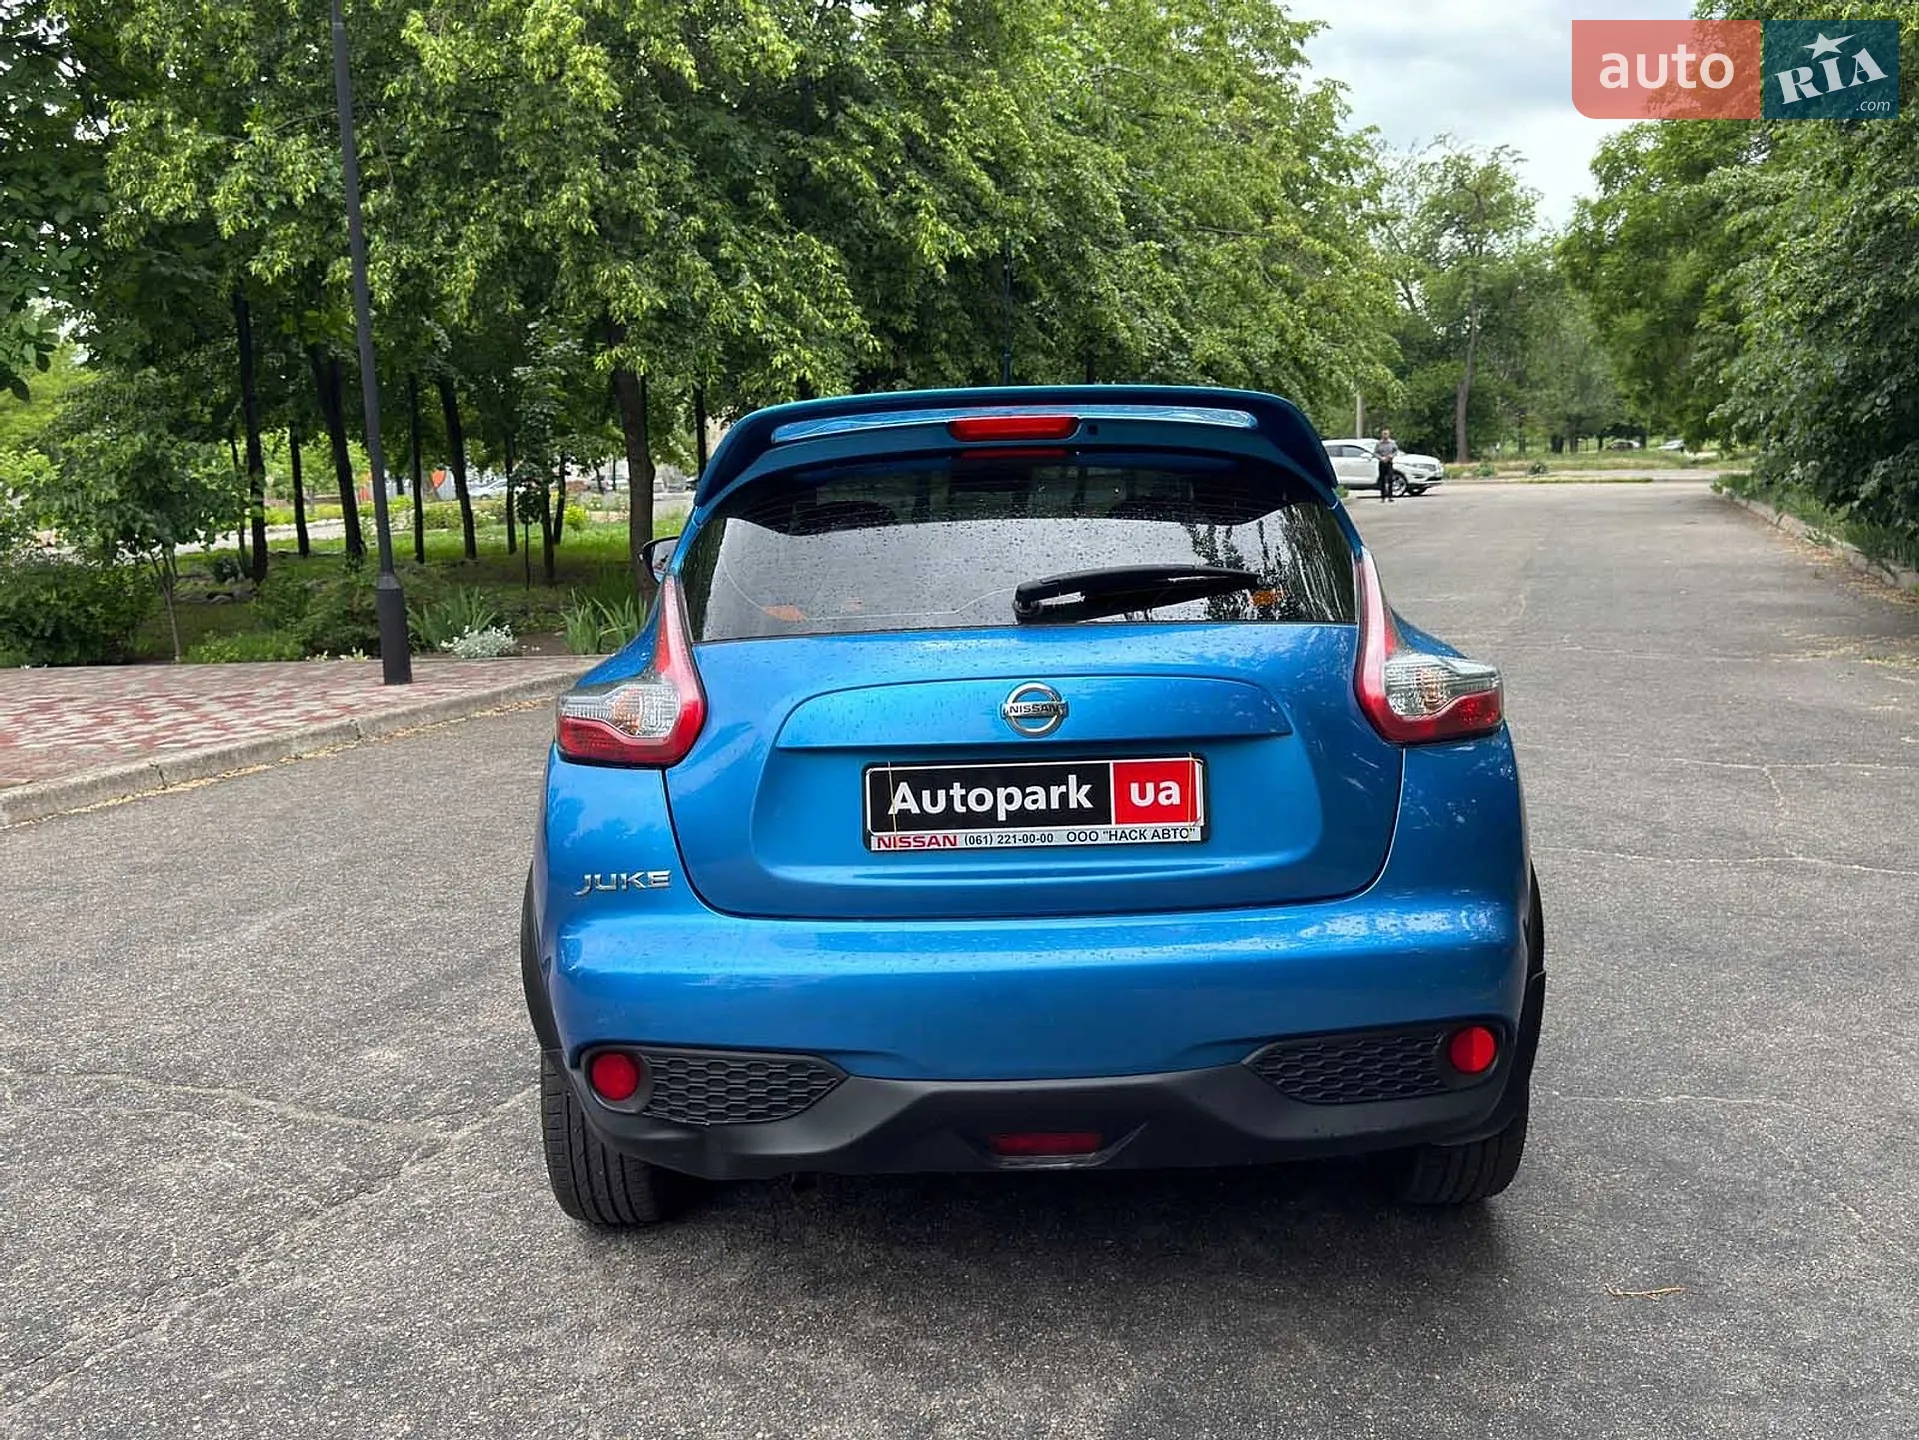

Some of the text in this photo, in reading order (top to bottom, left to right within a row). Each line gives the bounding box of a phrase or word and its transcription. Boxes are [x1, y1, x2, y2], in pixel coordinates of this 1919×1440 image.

[1009, 702, 1059, 714] NISSAN
[888, 774, 1181, 821] Autopark ua
[877, 832, 1054, 849] NISSAN (061) 221-00-00
[573, 869, 672, 896] JUKE
